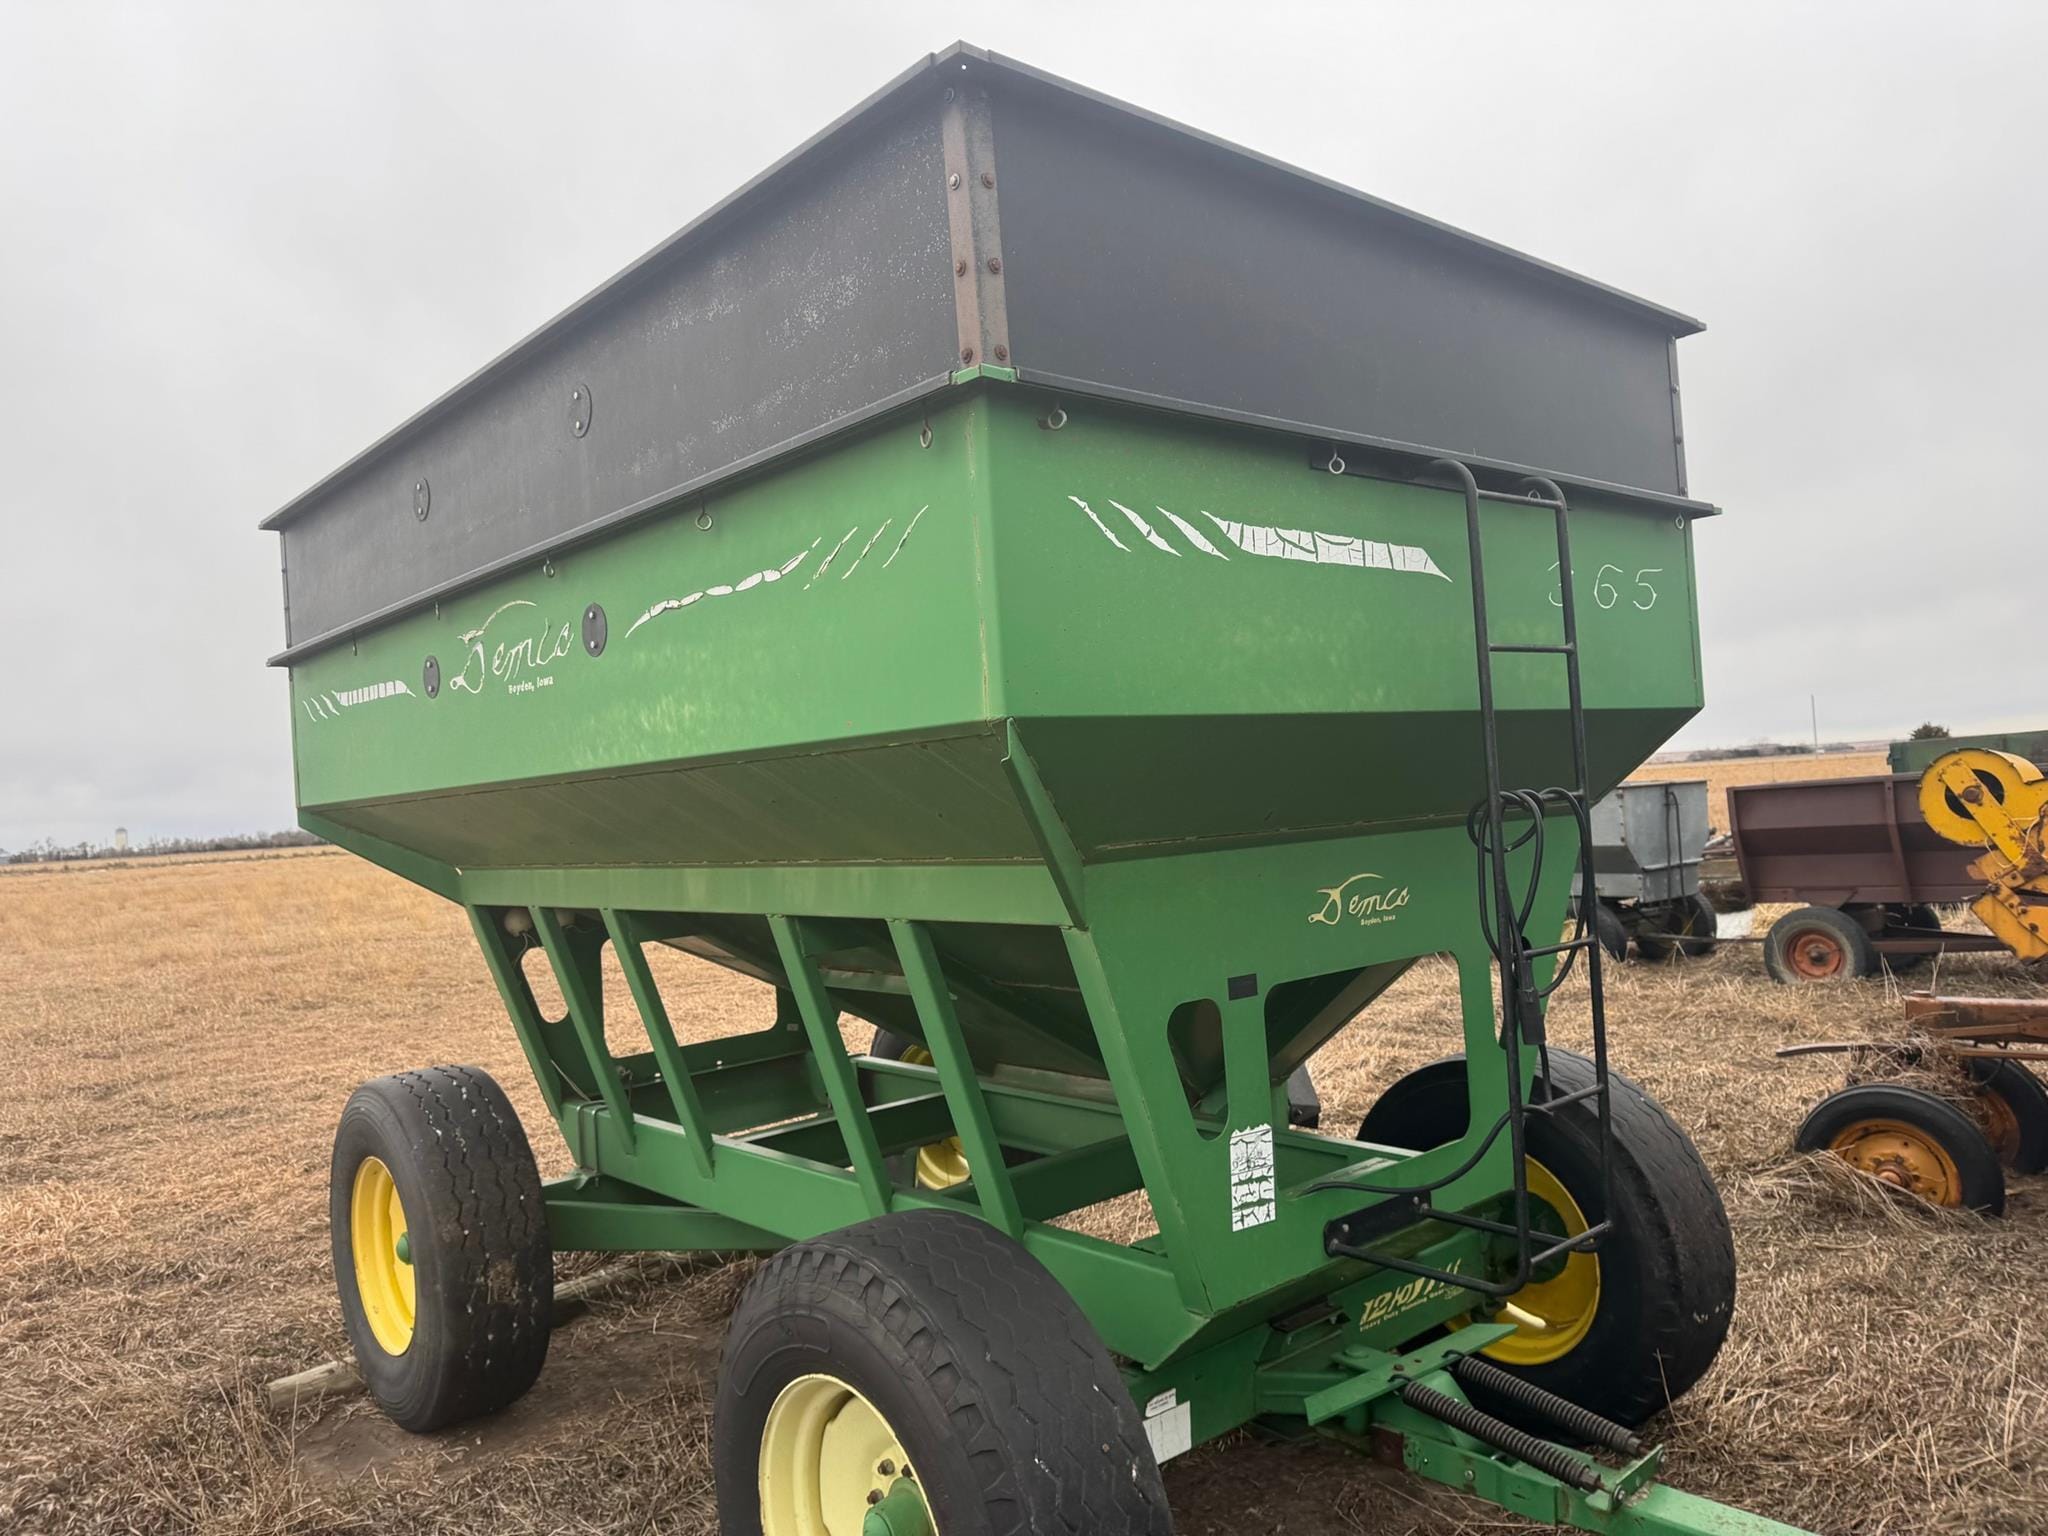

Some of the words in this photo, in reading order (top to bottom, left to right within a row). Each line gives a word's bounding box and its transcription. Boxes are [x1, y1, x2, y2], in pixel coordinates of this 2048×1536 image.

[449, 600, 575, 694] Demco
[536, 676, 553, 688] Iowa
[1308, 872, 1410, 925] Demco
